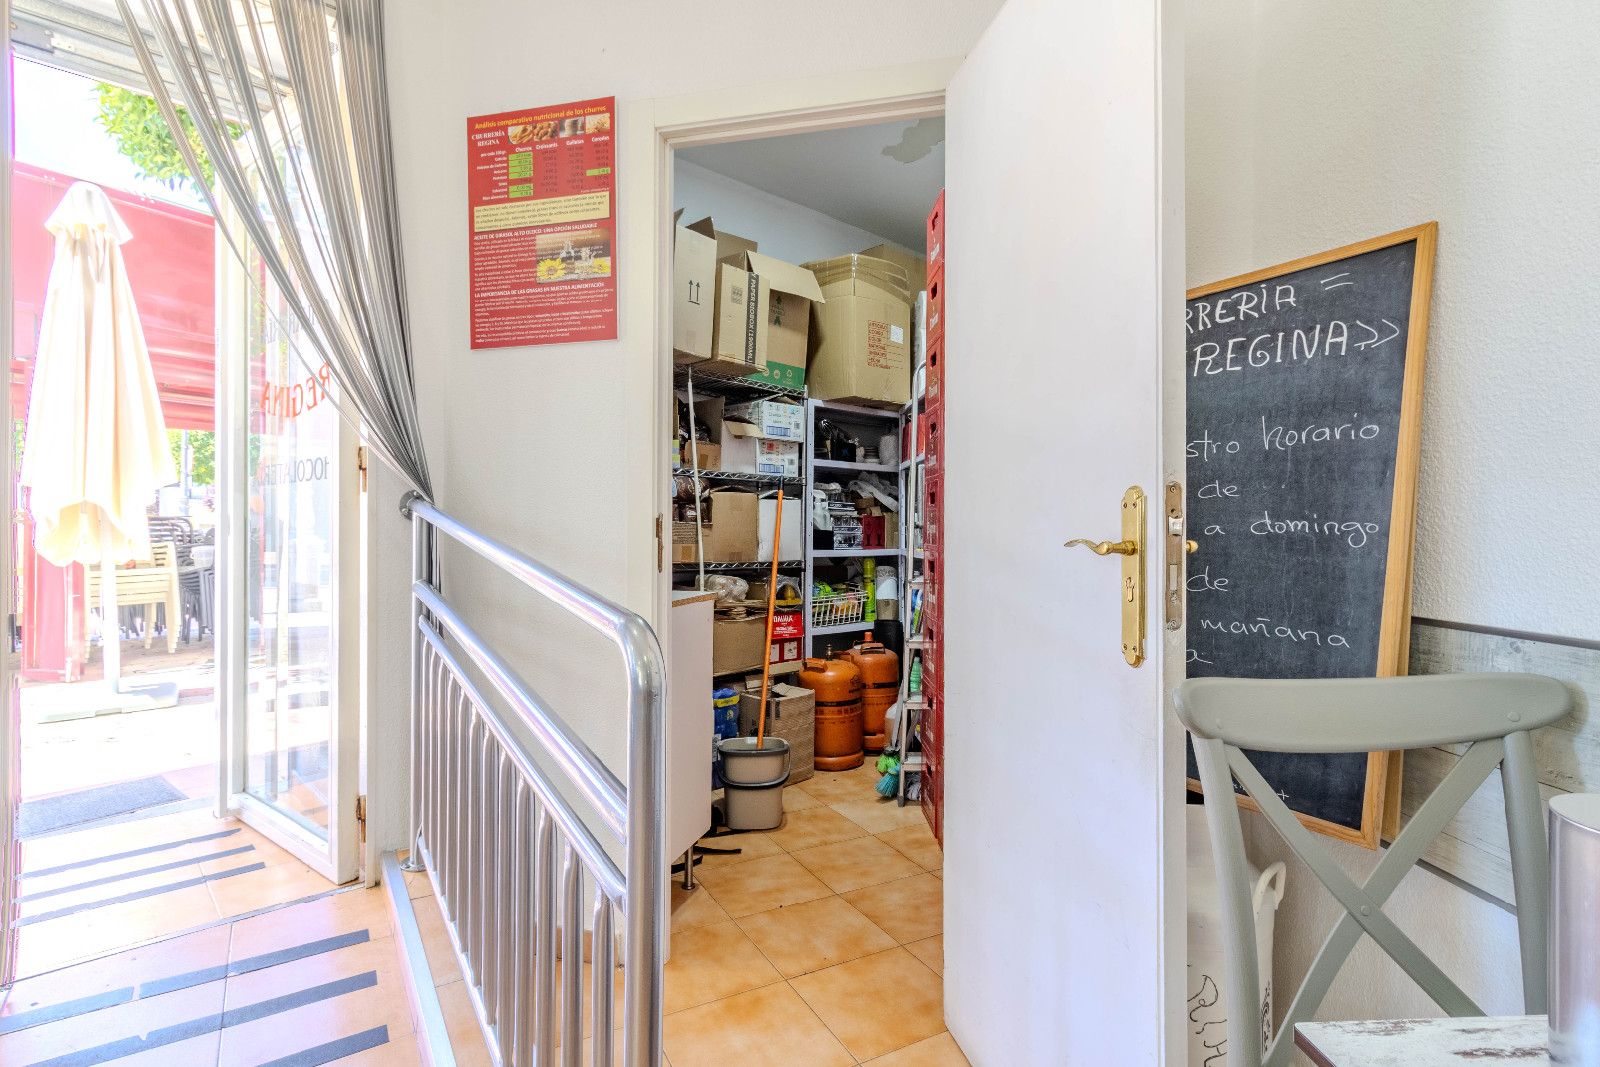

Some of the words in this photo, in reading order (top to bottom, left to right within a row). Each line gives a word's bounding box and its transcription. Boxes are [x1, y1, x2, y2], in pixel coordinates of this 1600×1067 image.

[498, 117, 532, 127] comparativo
[534, 111, 565, 121] nutricional
[585, 105, 606, 113] churros
[477, 138, 499, 146] REGINA
[1261, 412, 1380, 450] horario
[1198, 480, 1240, 498] de
[1204, 524, 1225, 535] a
[1250, 511, 1379, 548] domingo
[1186, 566, 1229, 592] de
[1201, 617, 1350, 648] mañana
